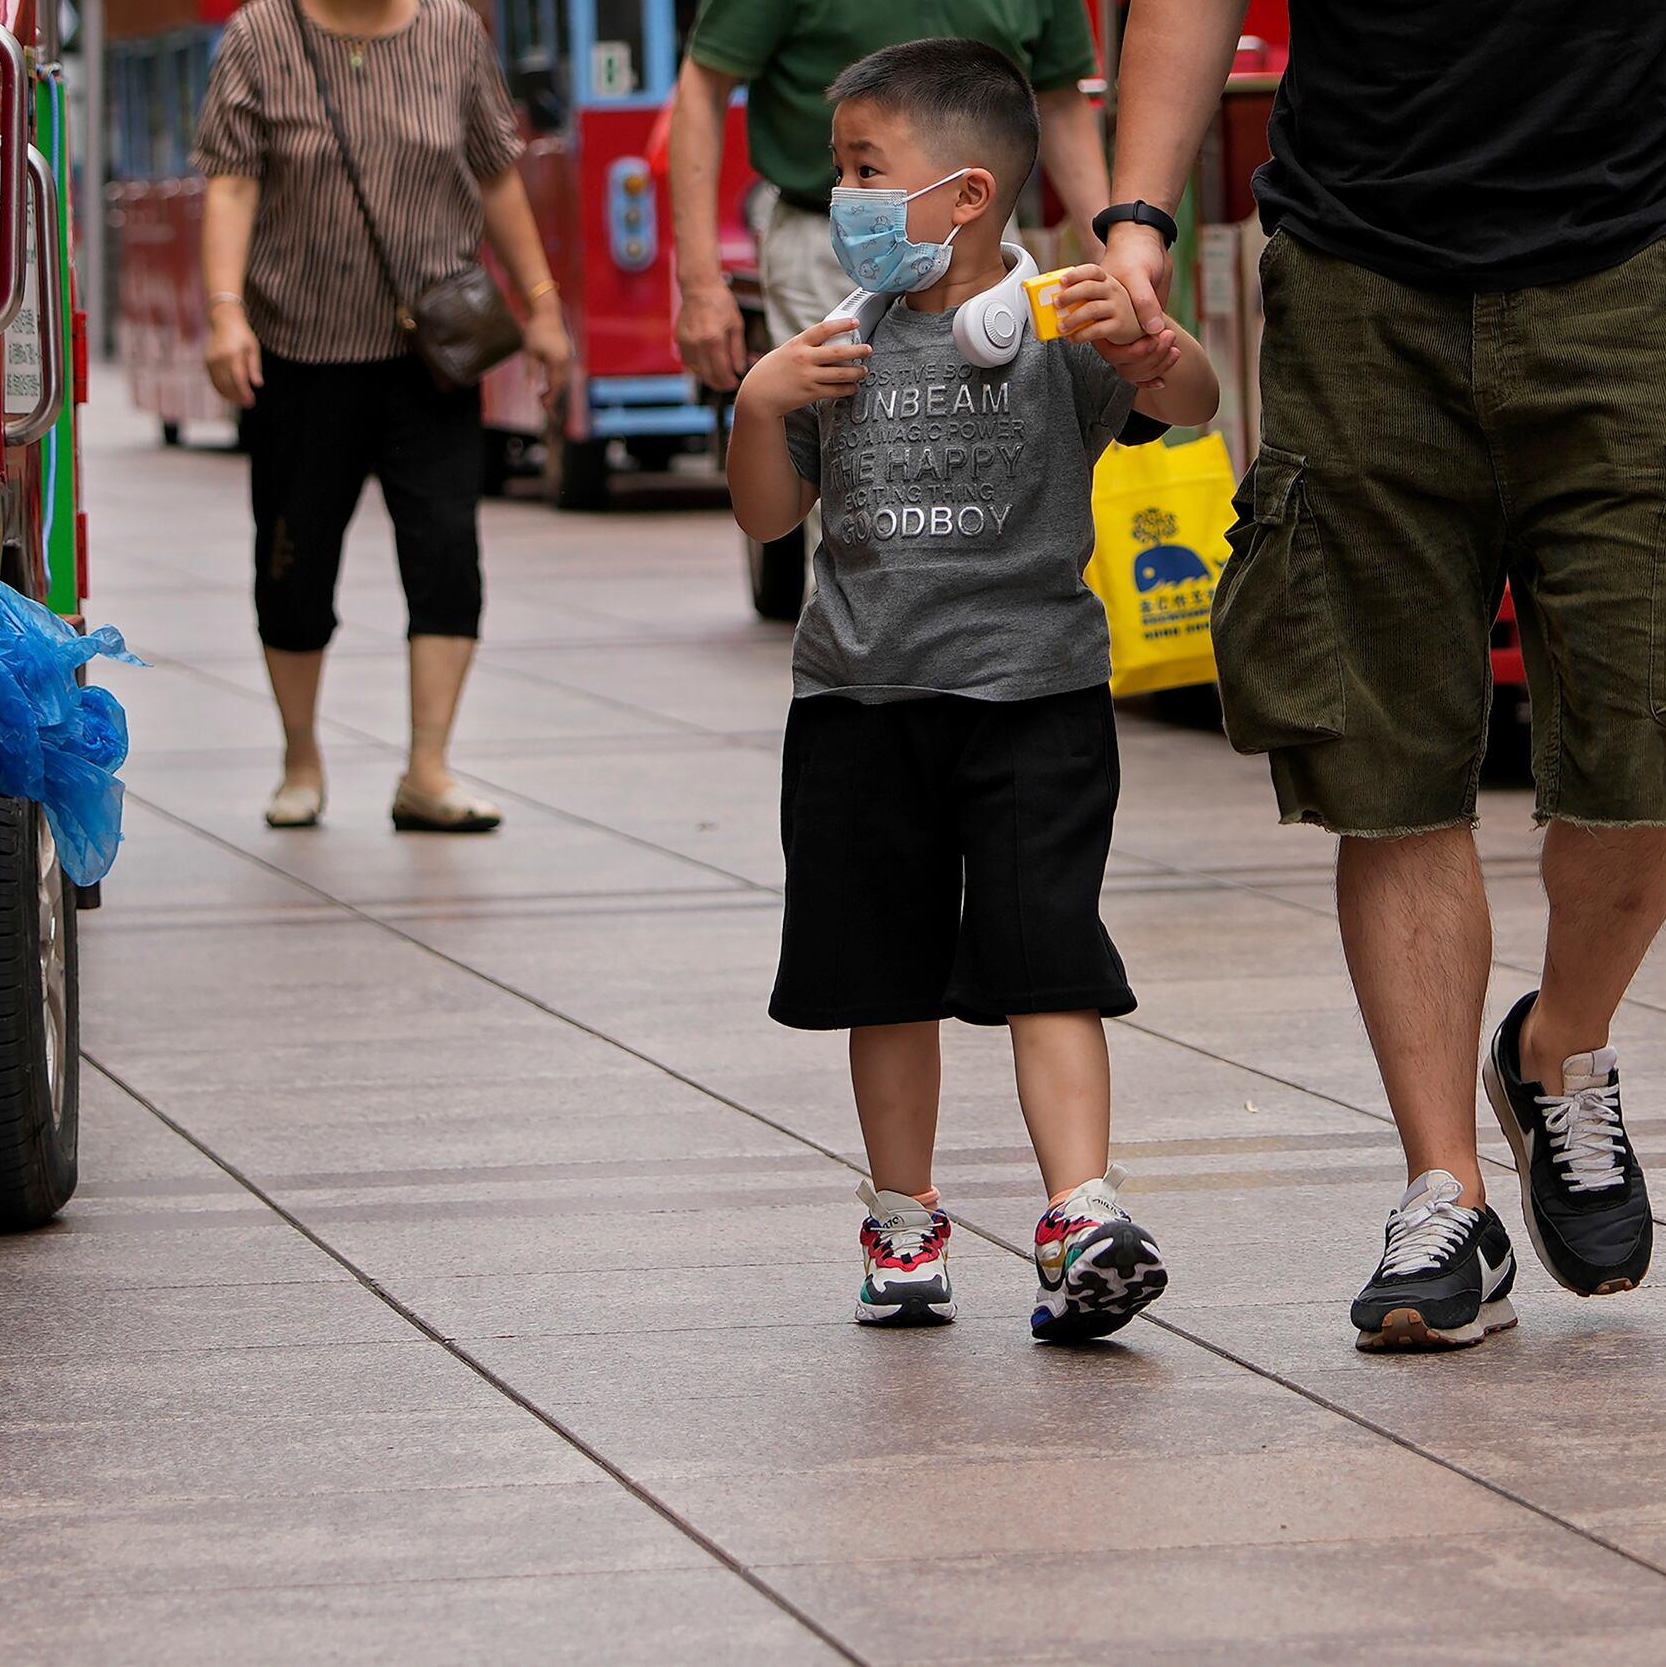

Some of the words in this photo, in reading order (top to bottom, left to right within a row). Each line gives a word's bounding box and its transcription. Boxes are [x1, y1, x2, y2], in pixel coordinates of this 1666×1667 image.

[947, 419, 1026, 441] POWER
[831, 449, 877, 492] THE
[885, 442, 1025, 483] HAPPY
[927, 482, 996, 505] THING
[840, 502, 1014, 547] GOODBOY
